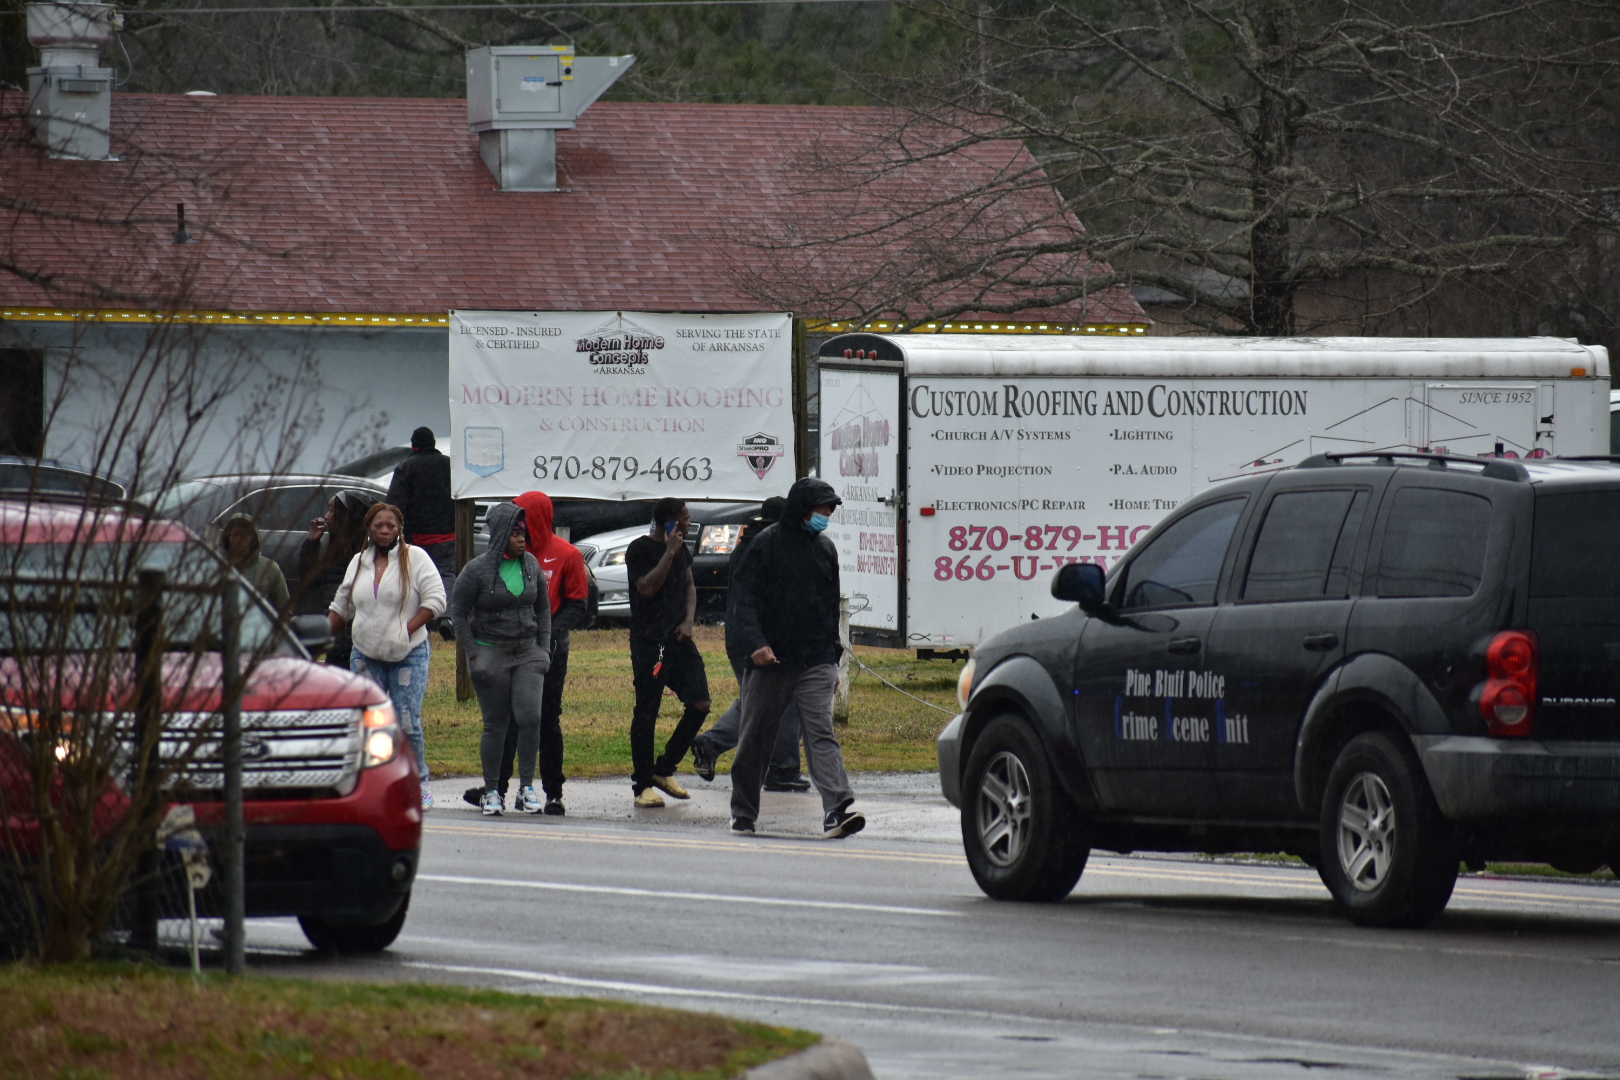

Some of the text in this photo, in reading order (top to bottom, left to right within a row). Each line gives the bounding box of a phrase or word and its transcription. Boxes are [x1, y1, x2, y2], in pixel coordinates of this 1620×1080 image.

[460, 326, 508, 336] LICENSED
[516, 327, 562, 336] INSURED
[676, 329, 781, 338] SERVING THE STATE
[475, 339, 540, 349] & CERTIFIED
[576, 335, 665, 352] Modern Home
[692, 342, 765, 352] OF ARKANSAS
[589, 349, 649, 367] Concepts
[599, 366, 645, 375] ARKANSAS
[461, 383, 784, 408] MODERN HOME ROOFING
[1459, 391, 1532, 405] SINCE 1952
[1102, 390, 1144, 416] AND
[539, 416, 705, 433] & CONSTRUCTION
[990, 429, 1014, 441] A/V
[532, 455, 713, 482] 870-879-4663
[1152, 499, 1180, 510] THE
[1125, 669, 1226, 699] Pine Bluff Police
